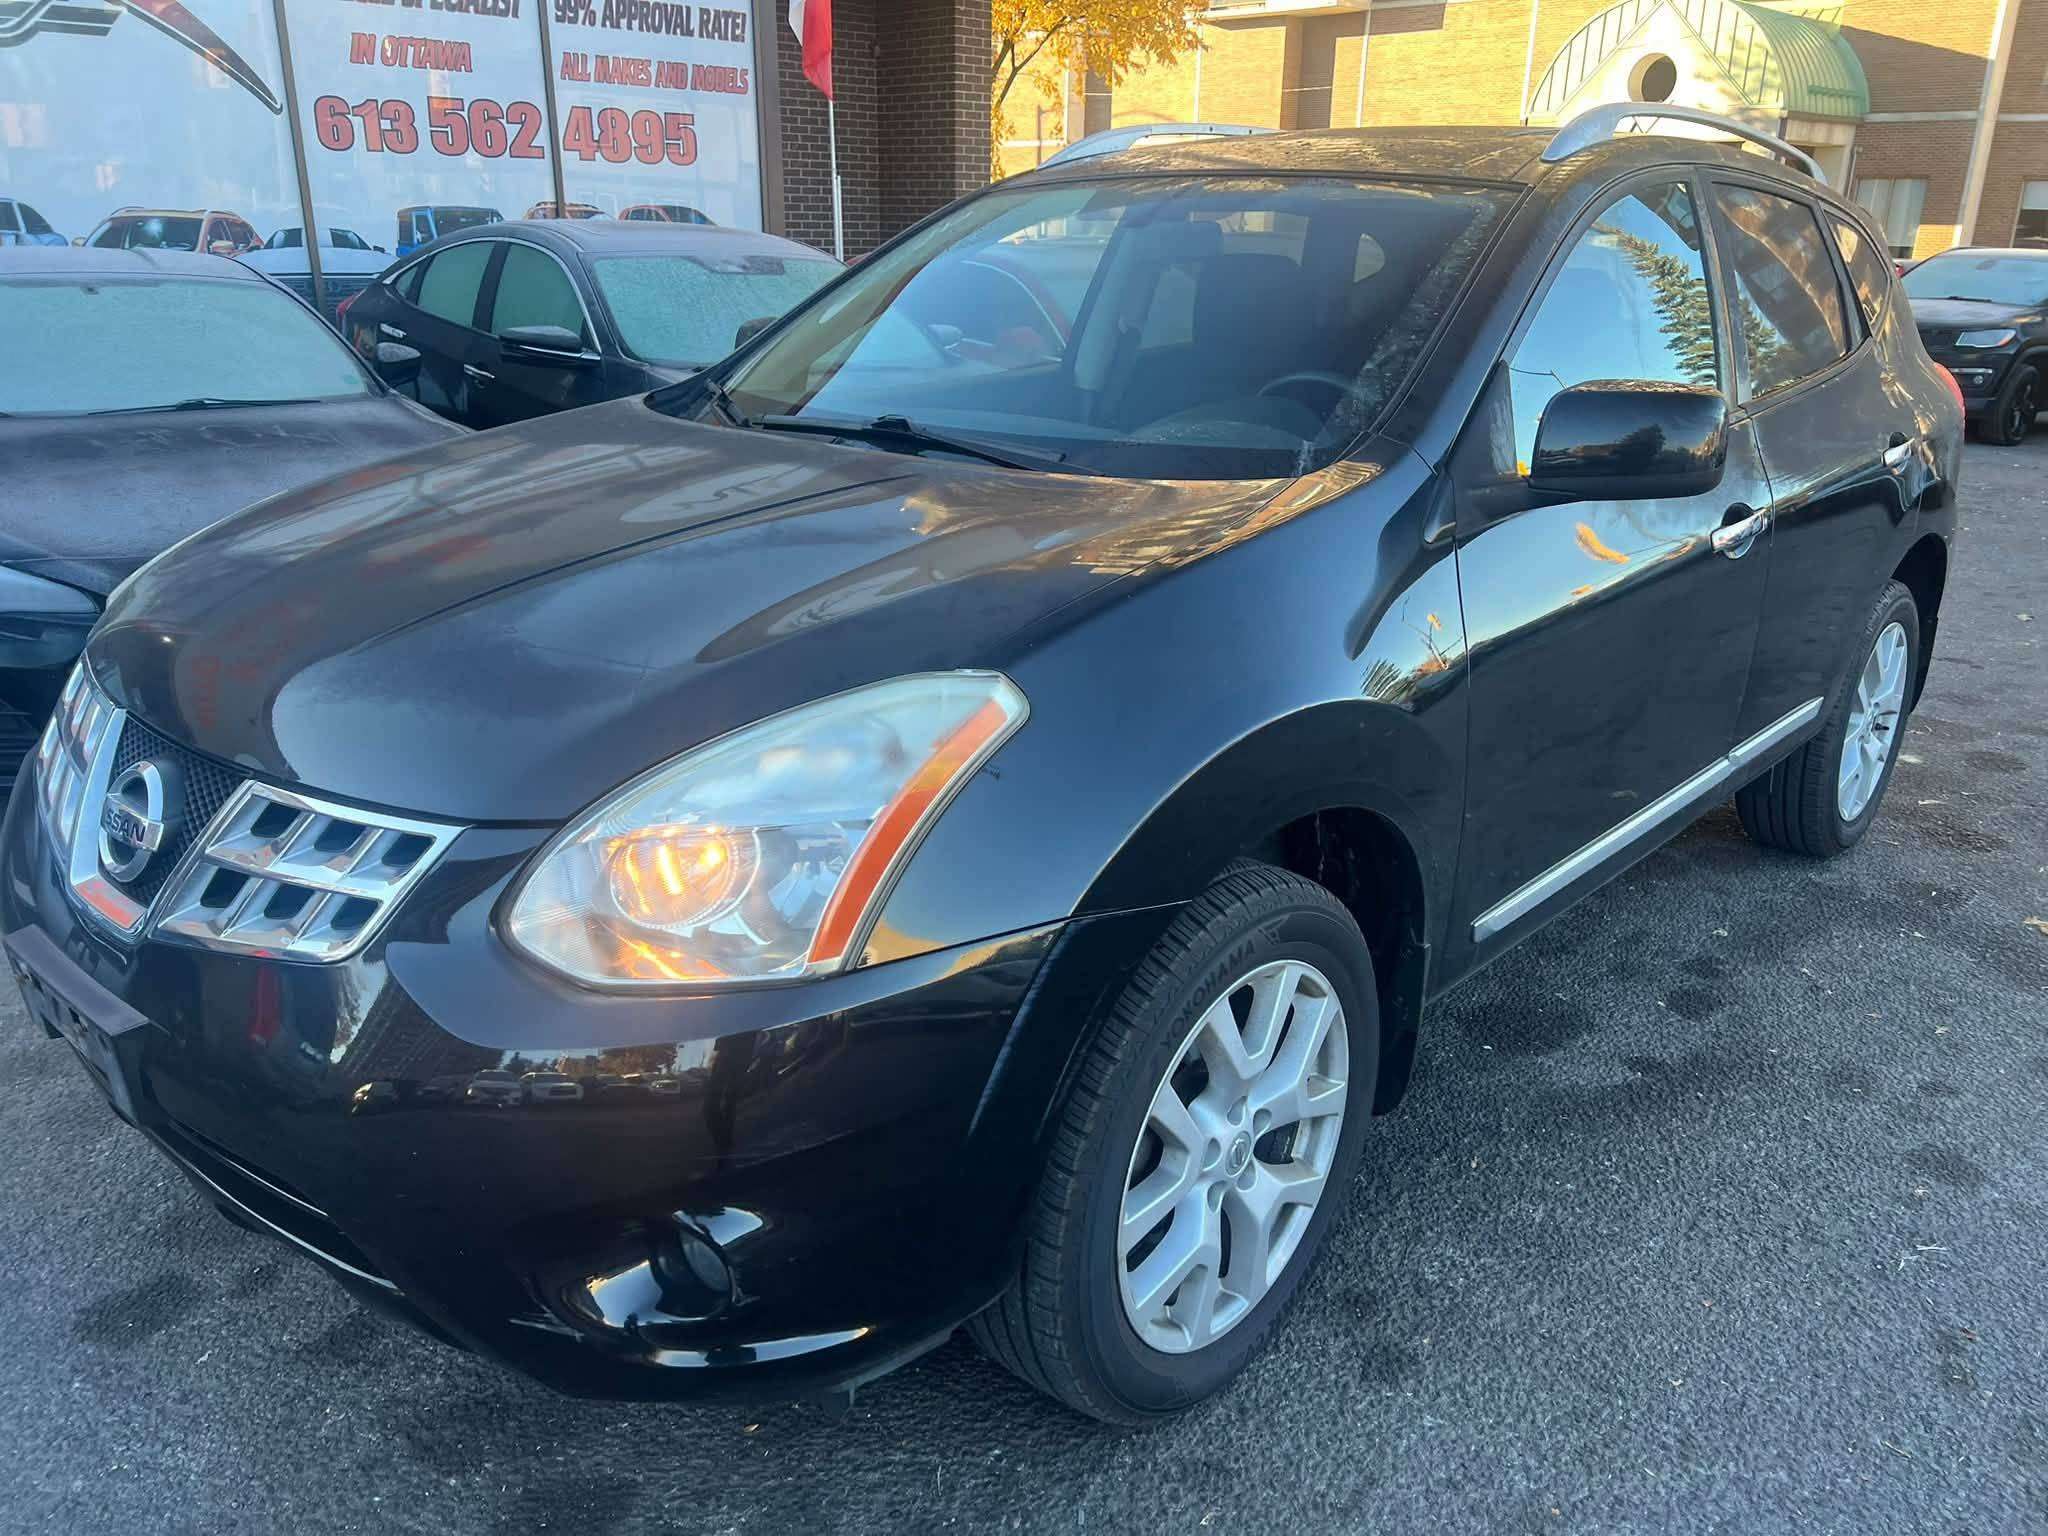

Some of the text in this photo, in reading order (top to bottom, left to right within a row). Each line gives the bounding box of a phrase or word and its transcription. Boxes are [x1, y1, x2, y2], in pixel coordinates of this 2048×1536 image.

[554, 0, 747, 43] 99% APPROVAL RATE!
[350, 32, 473, 73] IN OTTAWA
[560, 51, 749, 95] ALL MAKES AND MODELS
[314, 95, 698, 166] 613 562 4895
[1160, 938, 1256, 1053] YOKOHAMA
